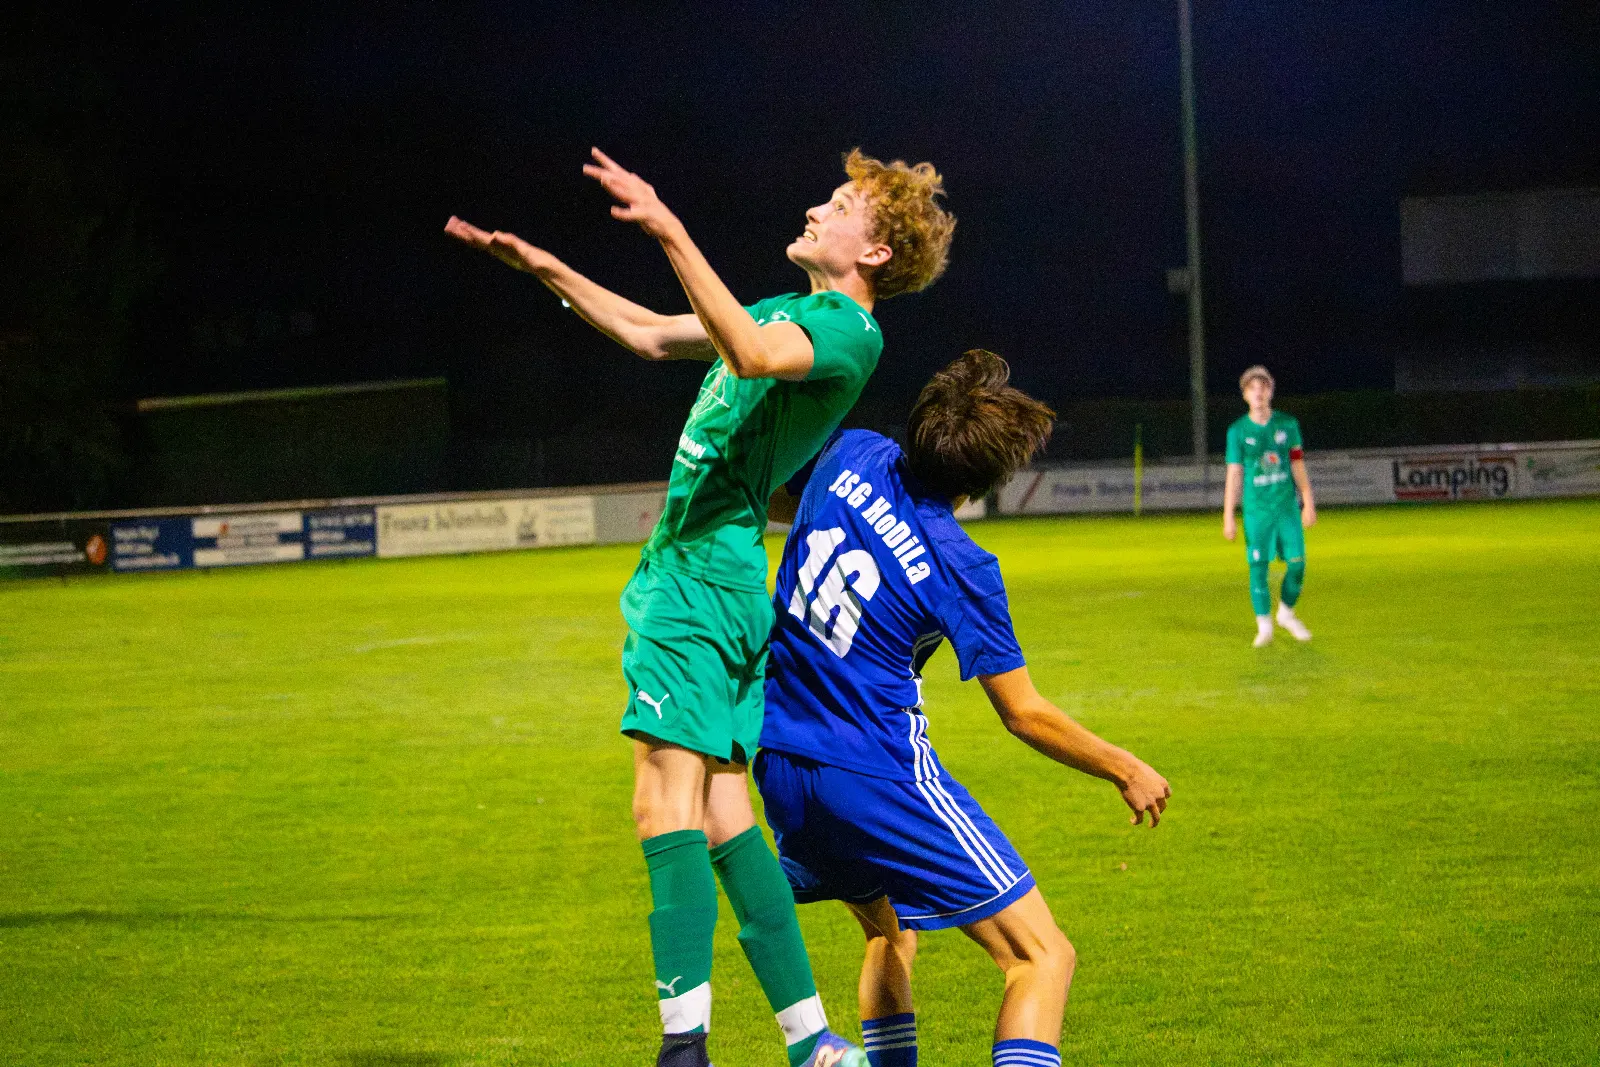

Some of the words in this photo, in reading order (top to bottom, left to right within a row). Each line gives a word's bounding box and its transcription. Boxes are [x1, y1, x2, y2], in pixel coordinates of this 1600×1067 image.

[830, 470, 873, 509] JSG
[862, 496, 931, 585] HoDiLa
[1393, 460, 1509, 497] Lamping
[788, 527, 880, 659] 16
